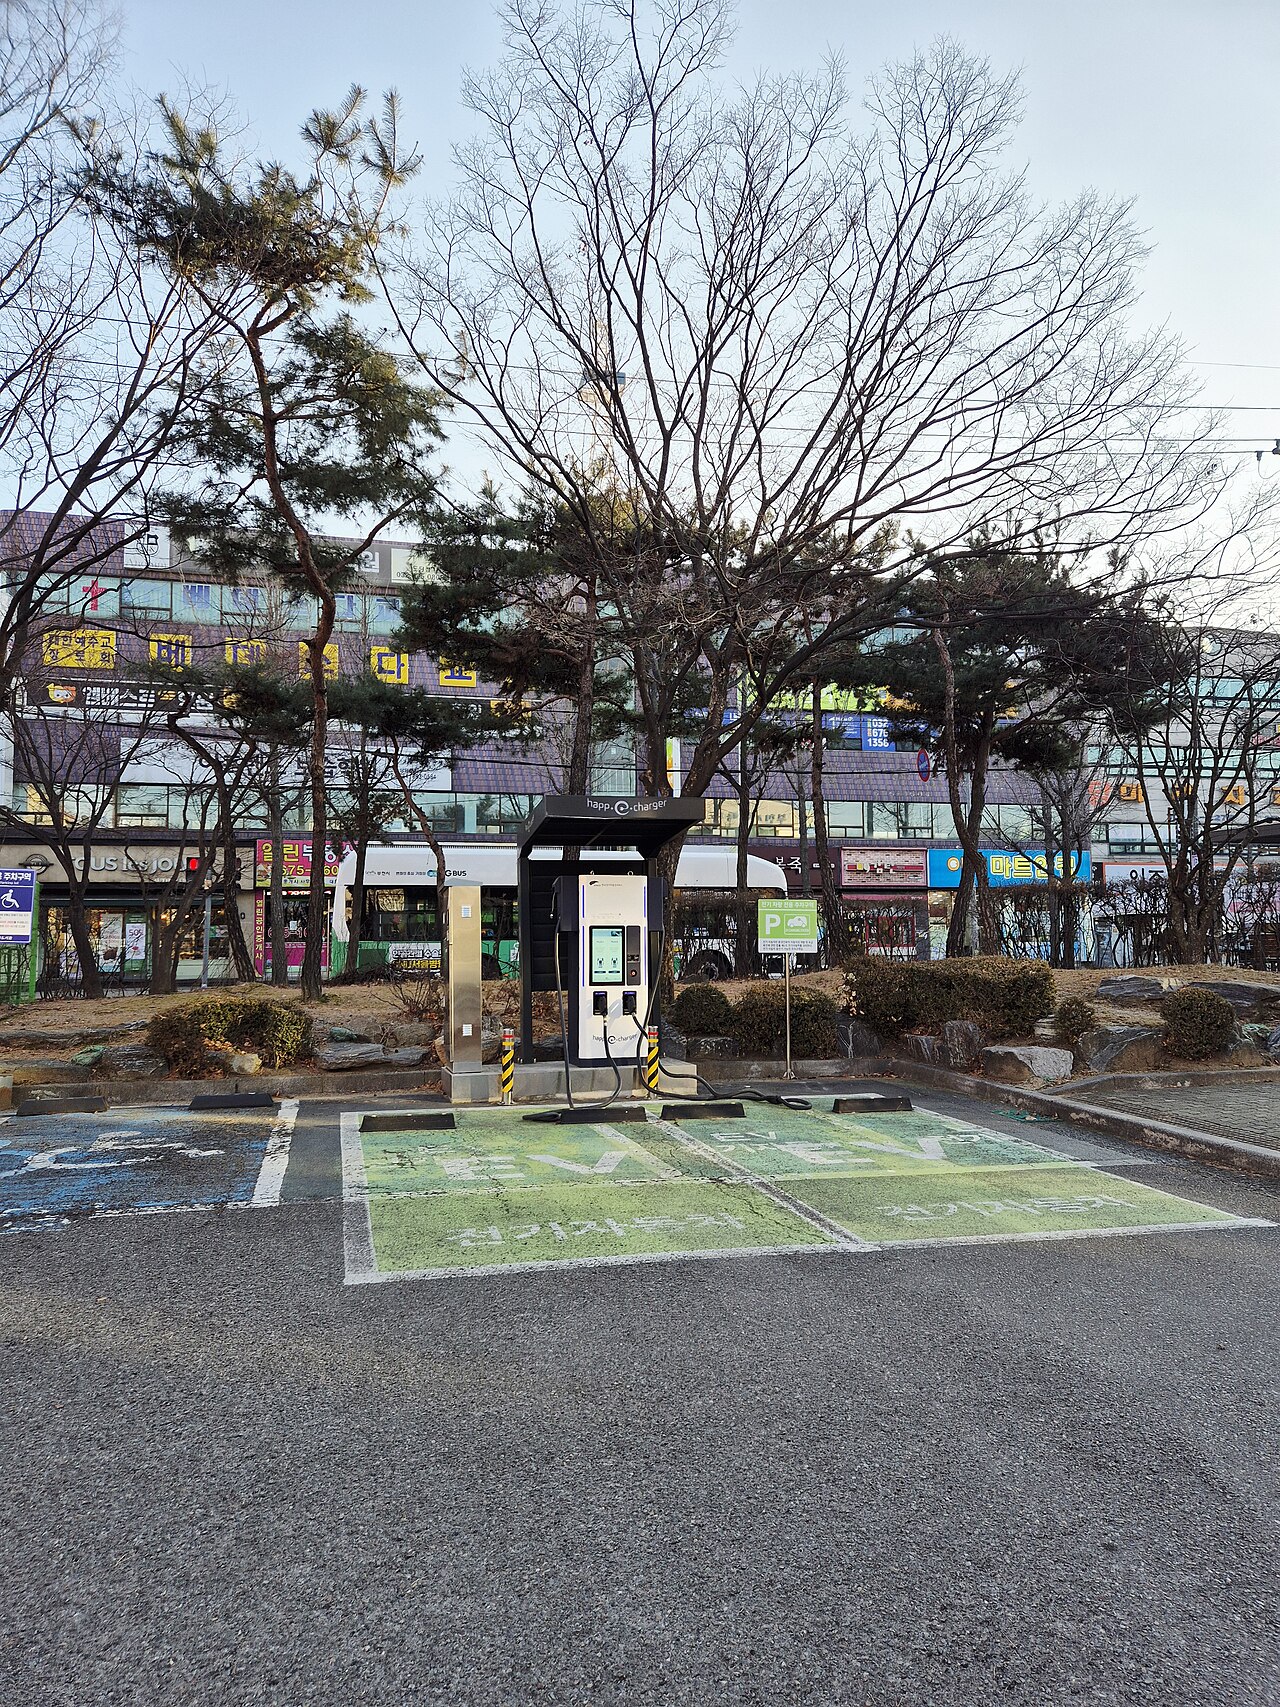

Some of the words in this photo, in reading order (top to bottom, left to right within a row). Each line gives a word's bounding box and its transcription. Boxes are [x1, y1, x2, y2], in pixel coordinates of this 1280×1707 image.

[867, 738, 889, 748] 1356
[4, 872, 32, 881] 주차구역
[765, 913, 782, 935] P
[433, 1151, 628, 1181] EV
